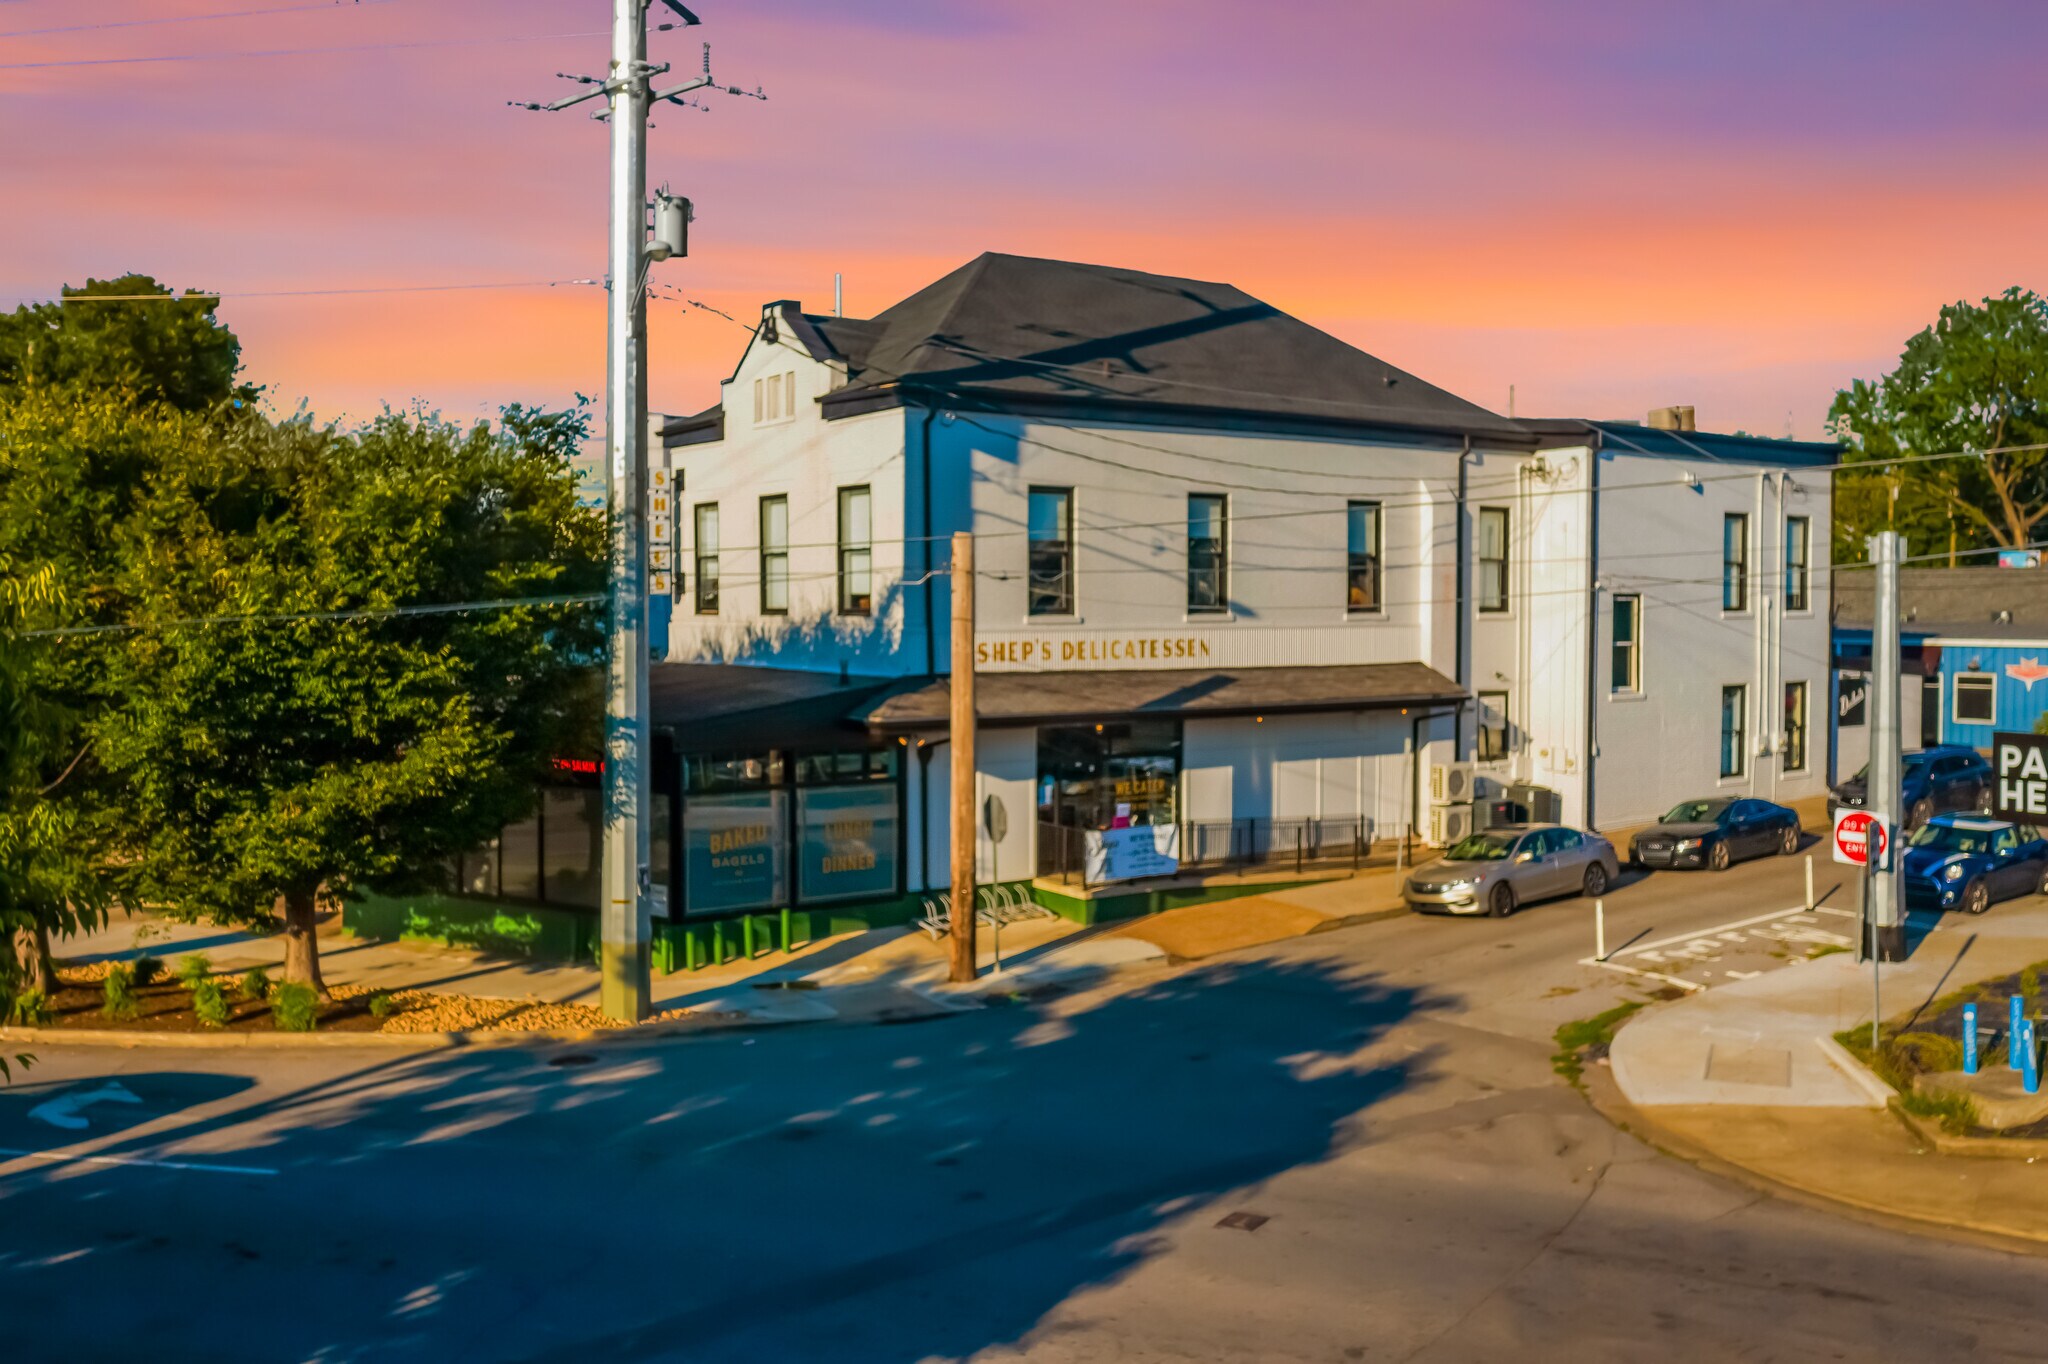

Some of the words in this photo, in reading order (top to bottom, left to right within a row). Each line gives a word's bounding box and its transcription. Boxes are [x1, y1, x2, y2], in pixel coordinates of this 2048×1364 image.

[977, 637, 1051, 664] SHEP'S
[1062, 638, 1211, 661] DELICATESSEN
[1843, 819, 1857, 831] DO
[710, 823, 768, 855] BAKED
[1846, 842, 1867, 855] ENT
[711, 853, 766, 868] BAGELS
